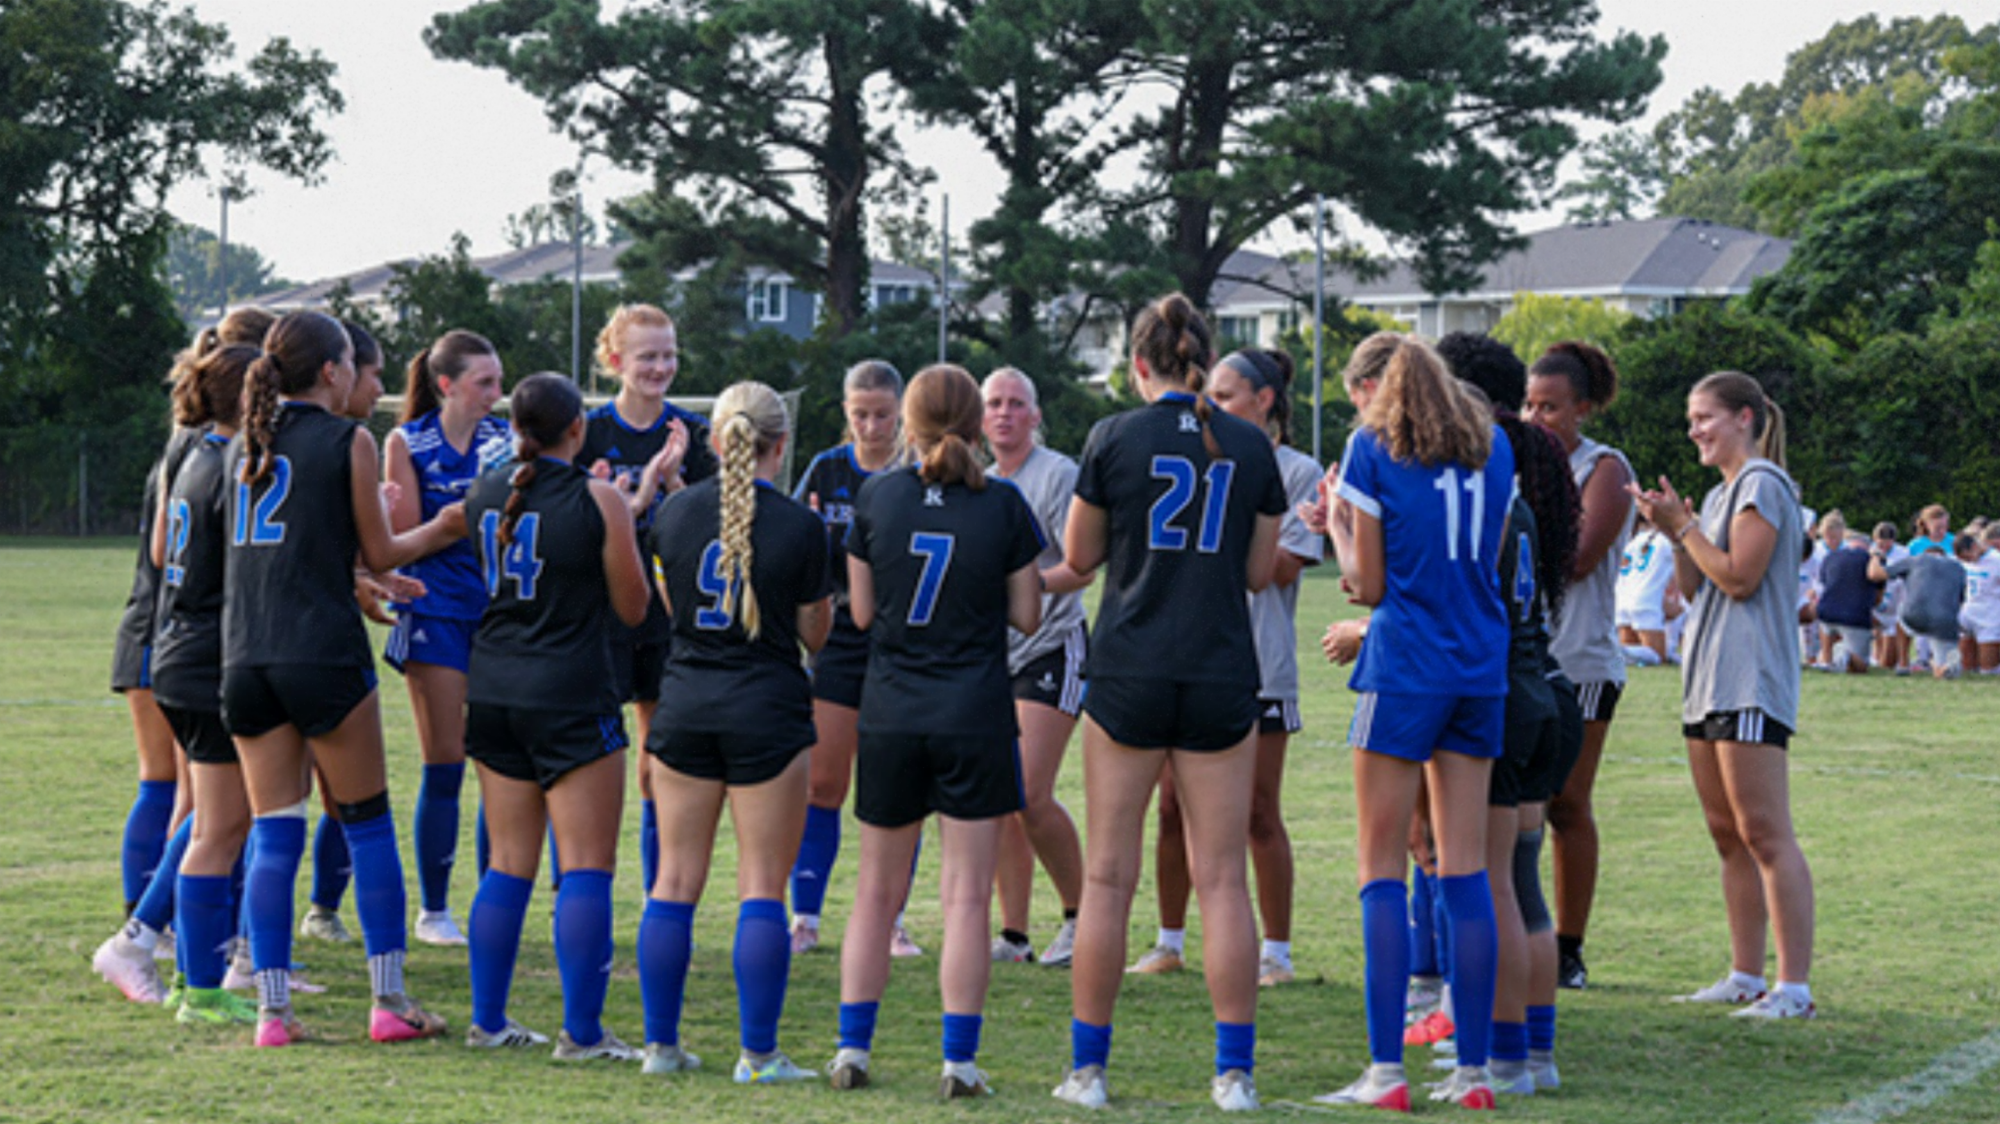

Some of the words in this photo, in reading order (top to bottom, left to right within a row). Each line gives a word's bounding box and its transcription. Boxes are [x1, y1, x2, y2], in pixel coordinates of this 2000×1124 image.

[234, 454, 291, 546] 12
[1149, 455, 1235, 553] 21
[1433, 468, 1485, 562] 11
[478, 509, 544, 599] 14
[907, 532, 954, 626] 7
